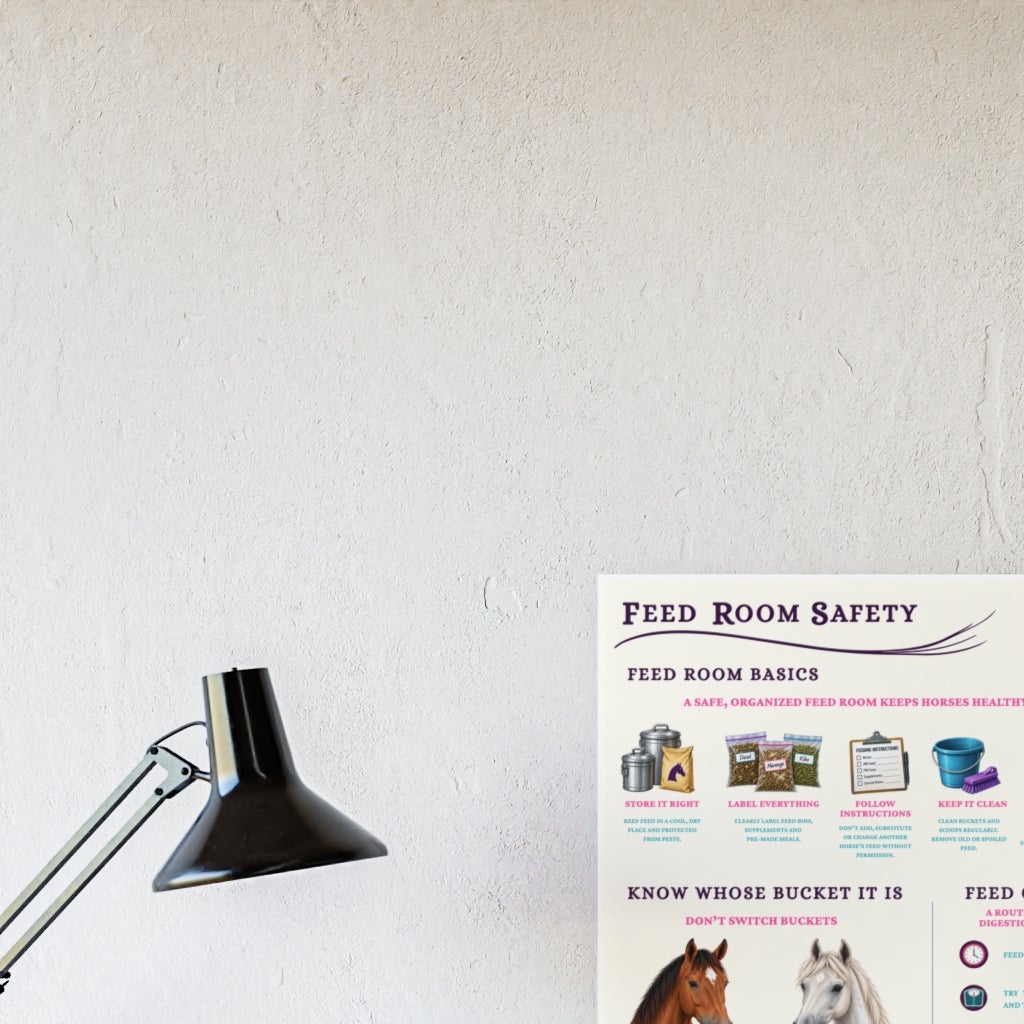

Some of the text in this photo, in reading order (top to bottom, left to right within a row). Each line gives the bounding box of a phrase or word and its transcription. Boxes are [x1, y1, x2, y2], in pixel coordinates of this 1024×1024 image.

[628, 668, 818, 681] FEED ROOM BASICS
[684, 698, 692, 707] A
[694, 698, 728, 709] SAFE,
[730, 698, 802, 707] ORGANIZED
[805, 698, 836, 707] FEED
[840, 698, 877, 707] ROOM
[880, 698, 918, 707] KEEPS
[922, 698, 969, 707] HORSES
[658, 800, 667, 808] IT
[760, 800, 820, 808] EVERYTHING
[856, 800, 896, 808] FOLLOW
[938, 800, 962, 808] KEEP
[976, 800, 1007, 808] CLEAN
[840, 810, 911, 818] INSTRUCTIONS
[628, 886, 902, 900] KNOW WHOSE BUCKET IT IS
[966, 887, 1014, 900] FEED
[986, 909, 992, 917] A
[686, 915, 837, 926] DON’T SWITCH BUCKETS
